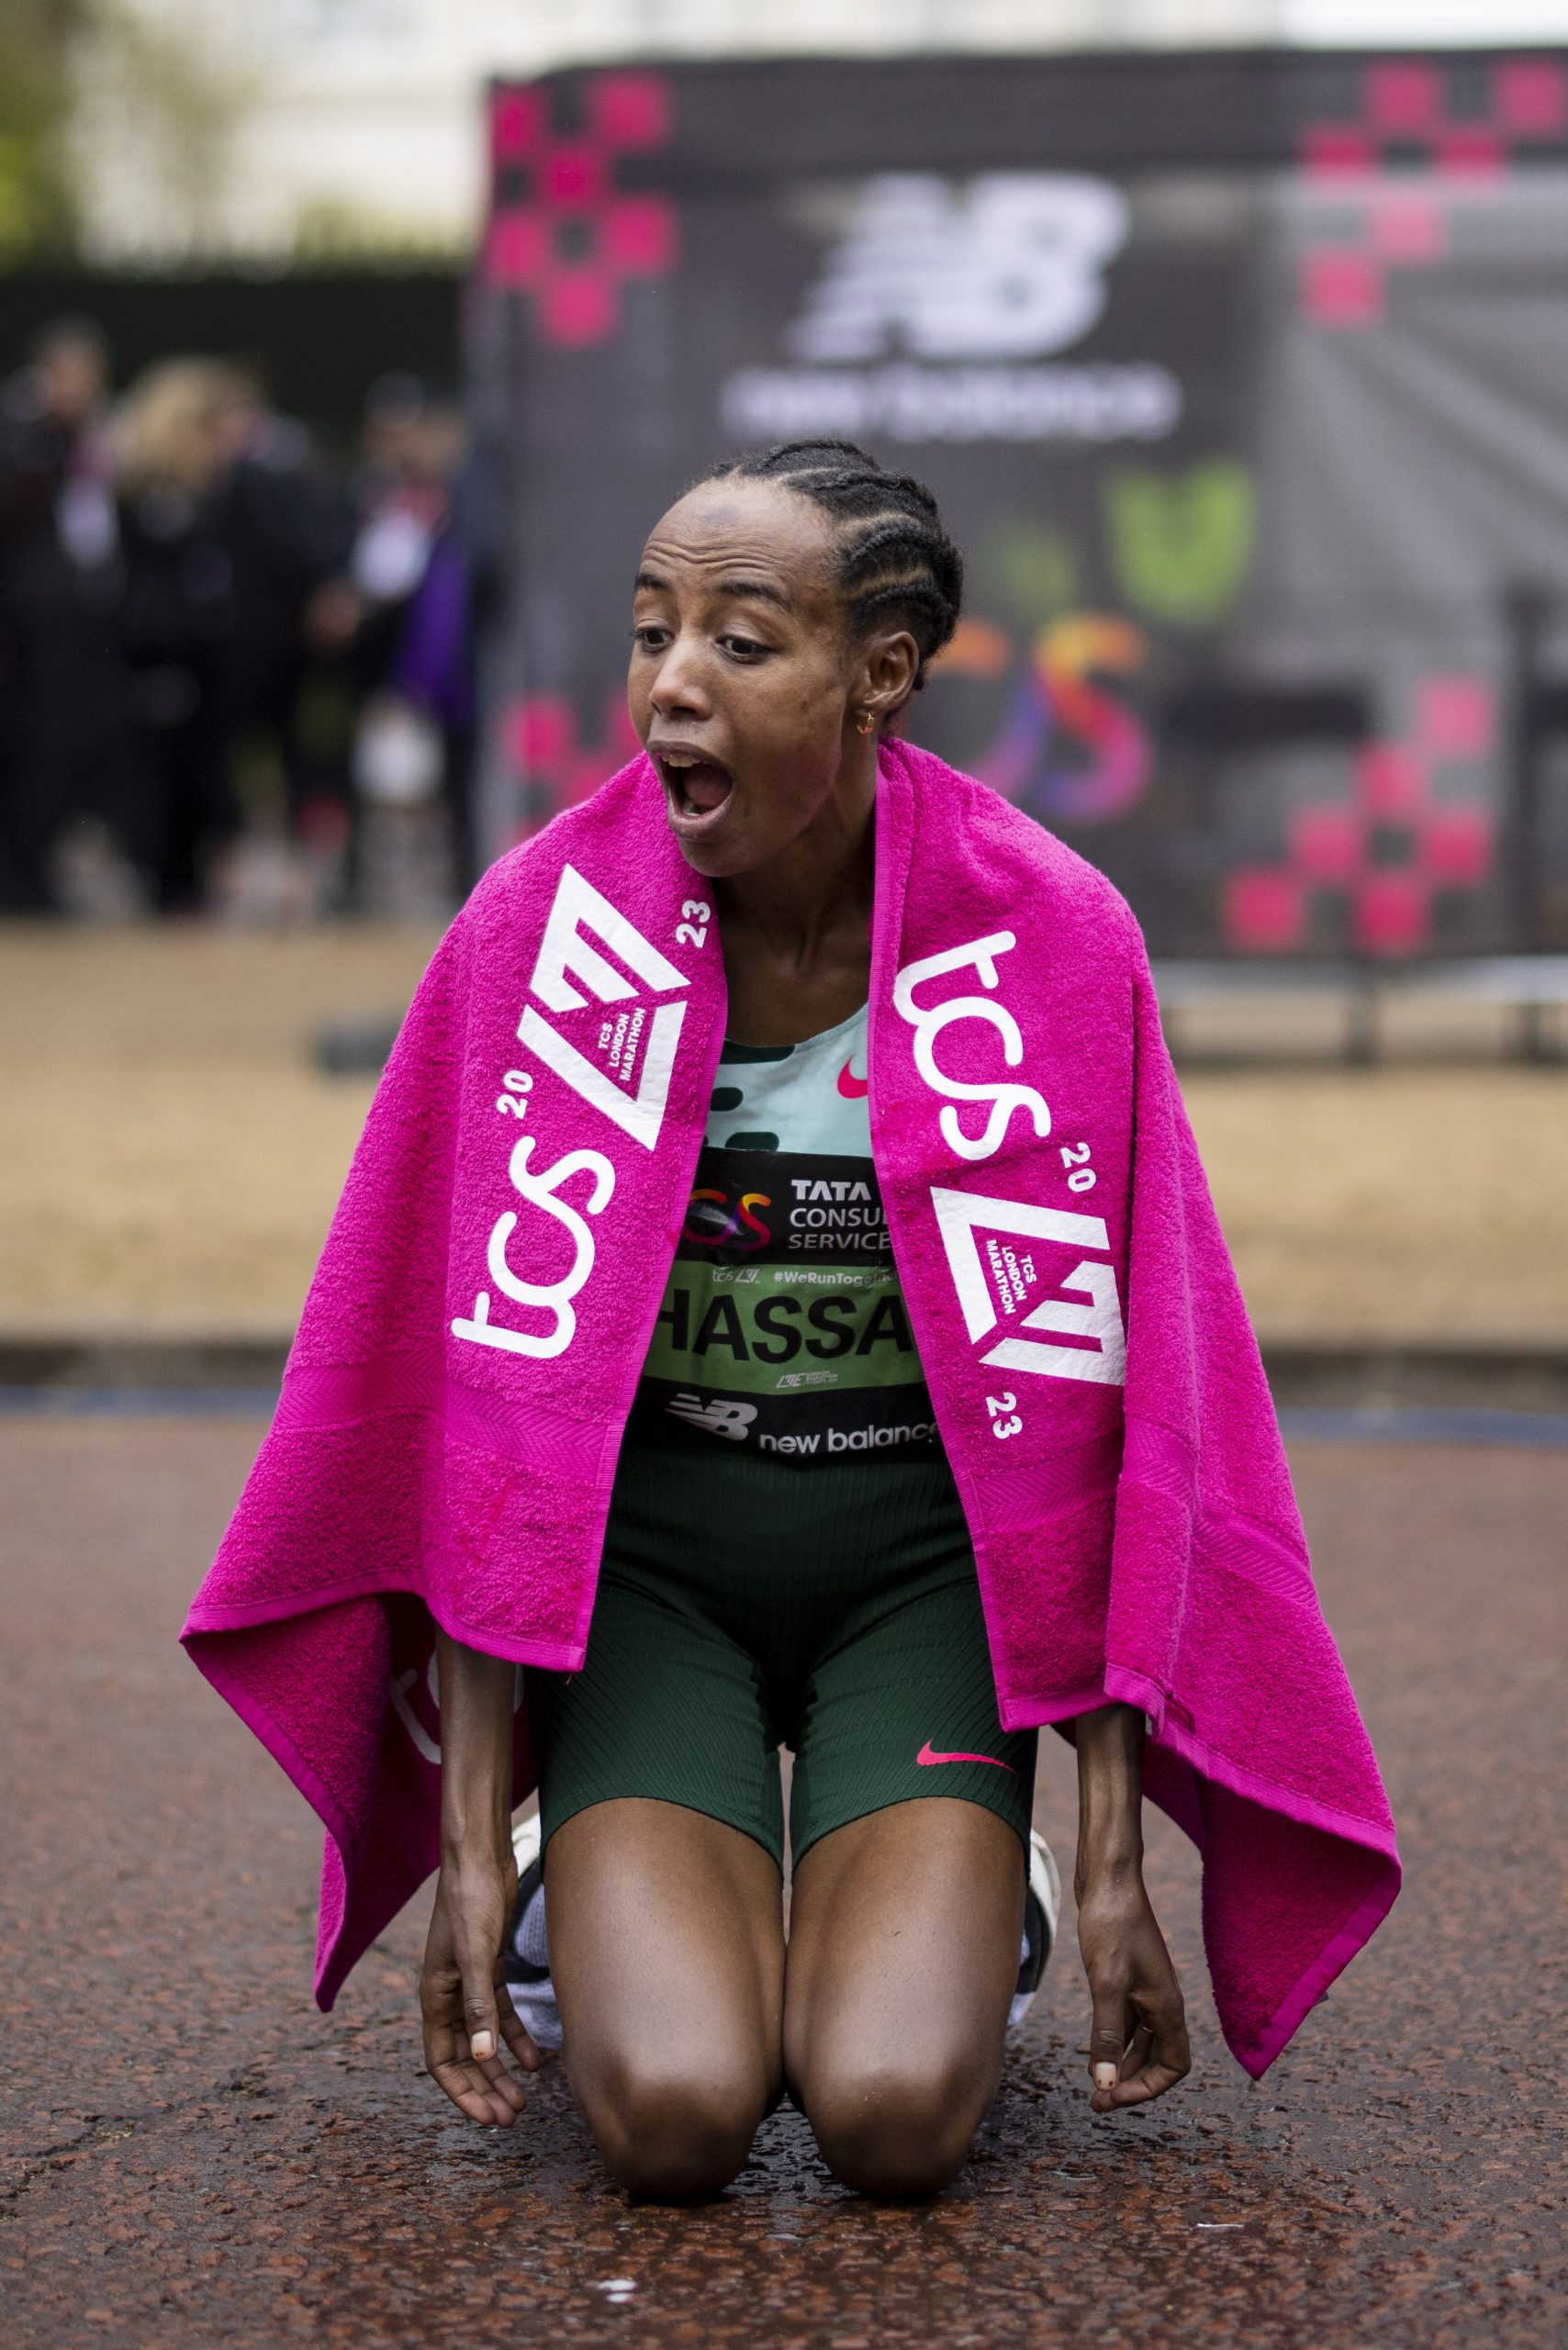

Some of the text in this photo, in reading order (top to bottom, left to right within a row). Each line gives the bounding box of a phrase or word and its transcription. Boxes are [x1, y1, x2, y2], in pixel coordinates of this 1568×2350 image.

[676, 900, 711, 948] 23
[599, 1023, 613, 1049] TCS
[609, 1013, 630, 1068] LONDON
[620, 1007, 645, 1080] MARATHON
[497, 1069, 533, 1119] 20
[791, 1180, 871, 1201] TATA
[1060, 1142, 1096, 1193] 20
[987, 1239, 1016, 1315] MARATHON
[1002, 1247, 1027, 1301] LONDON
[1021, 1255, 1036, 1283] TCS
[986, 1392, 1022, 1439] 23
[759, 1434, 820, 1453] new
